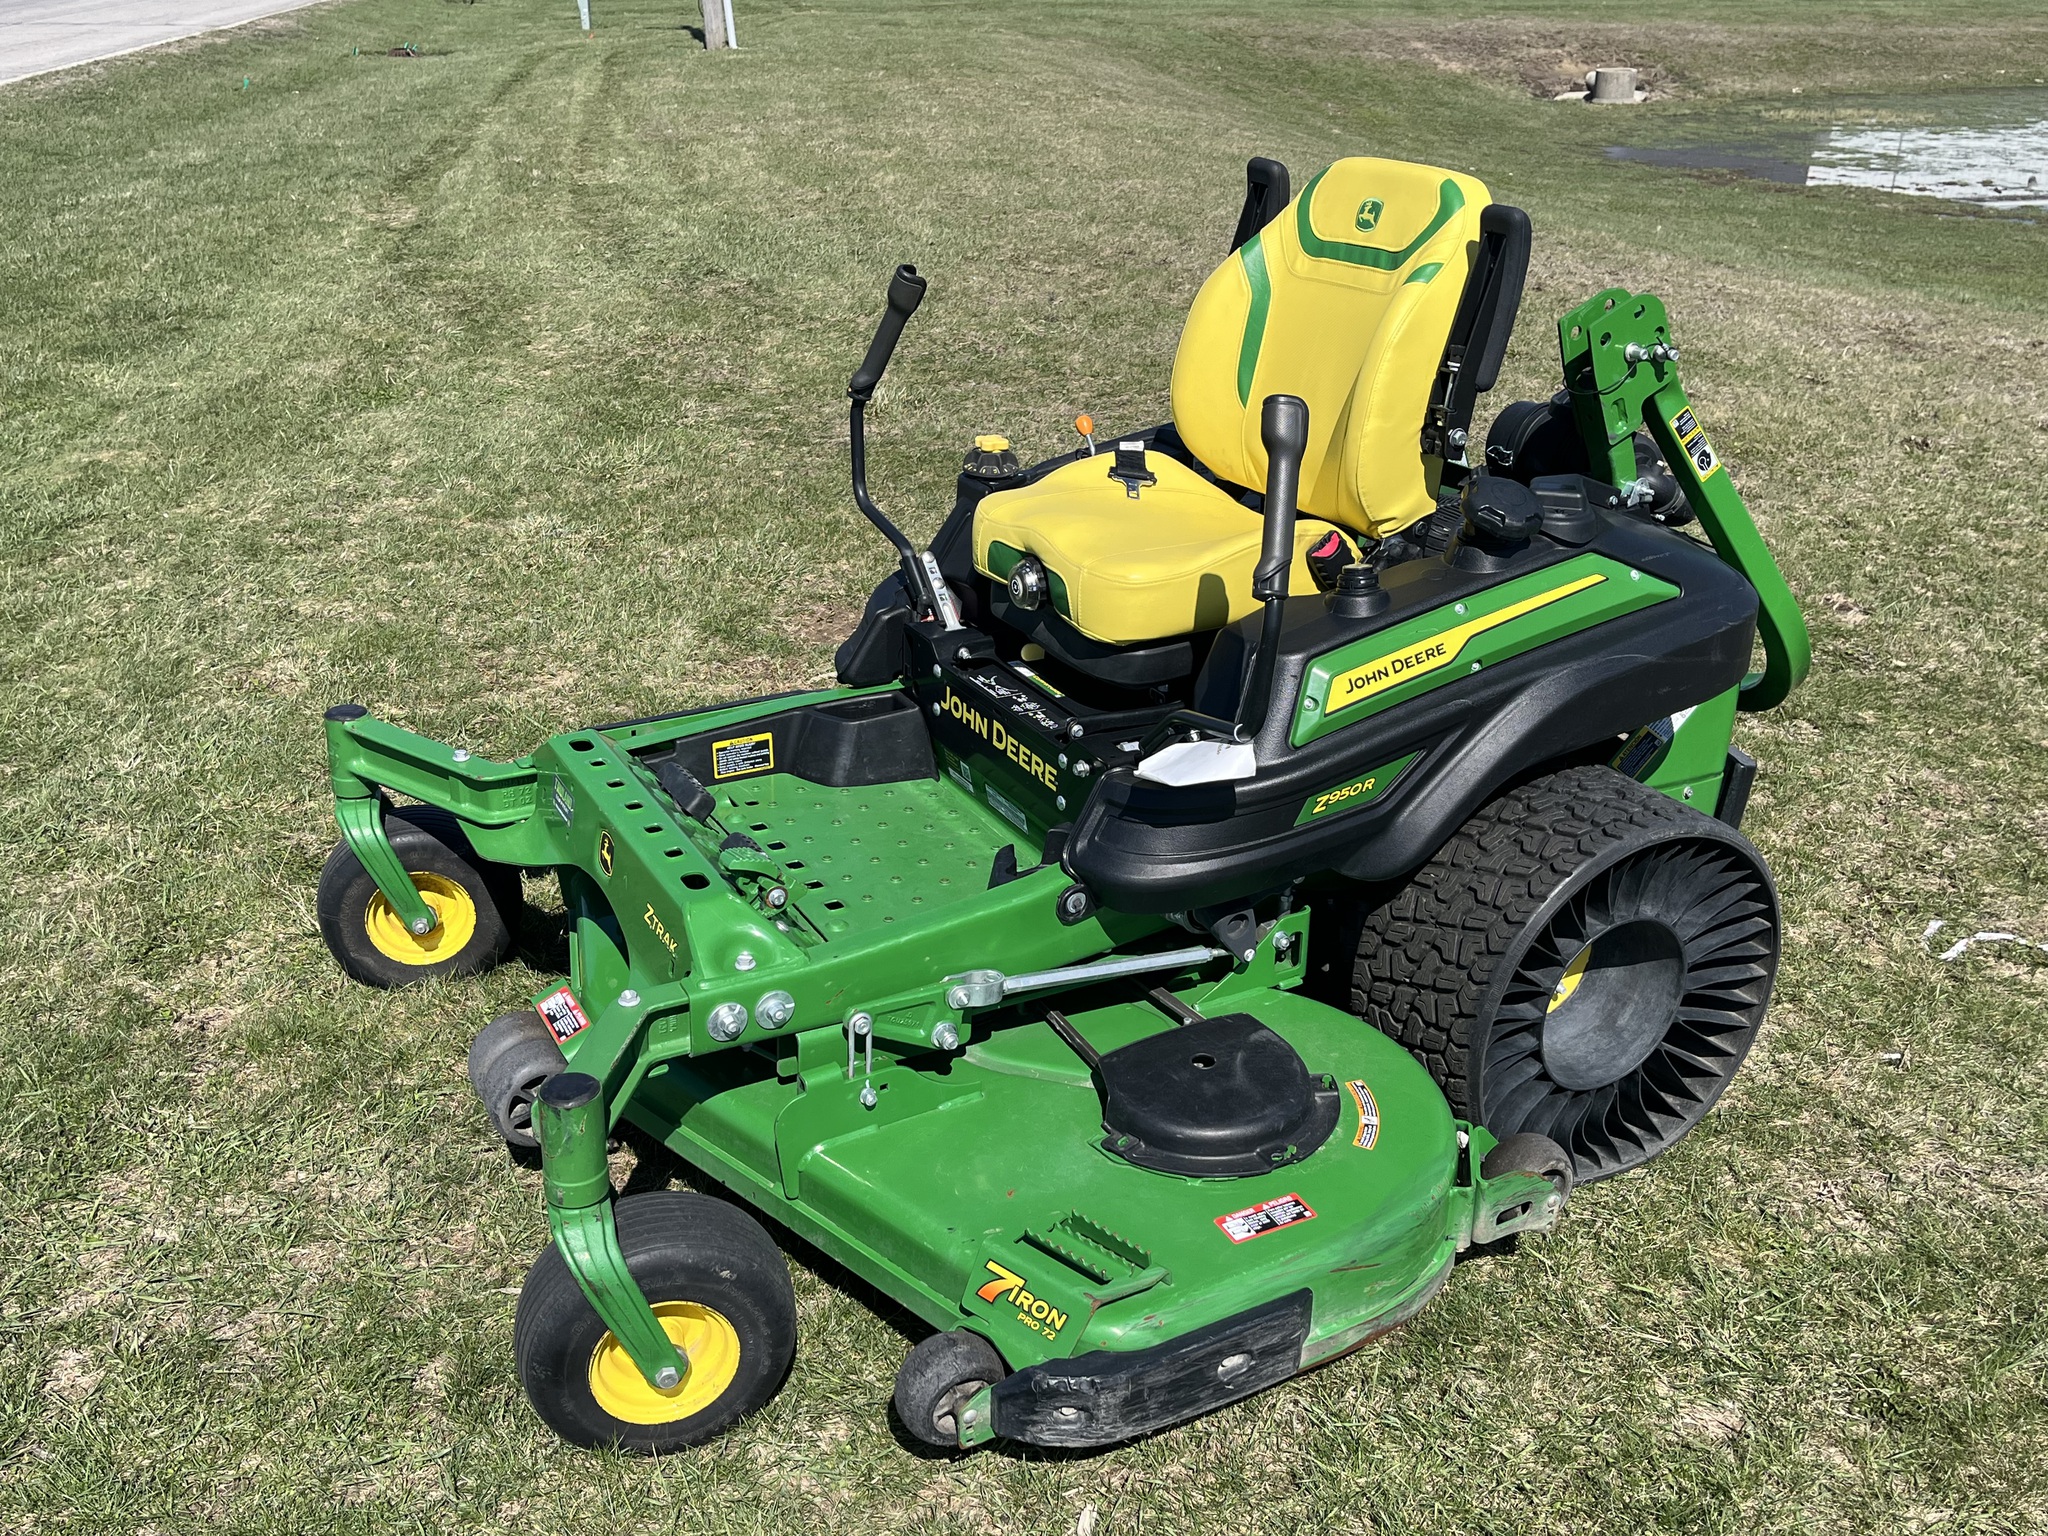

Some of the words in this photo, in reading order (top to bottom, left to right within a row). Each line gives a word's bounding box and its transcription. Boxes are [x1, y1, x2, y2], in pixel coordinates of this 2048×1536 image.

[1346, 666, 1389, 694] JOHN
[1391, 643, 1446, 674] DEERE
[940, 686, 988, 740] JOHN
[992, 719, 1058, 792] DEERE
[1311, 777, 1376, 815] Z950R
[1016, 1311, 1041, 1331] PRO
[1041, 1326, 1057, 1341] 72
